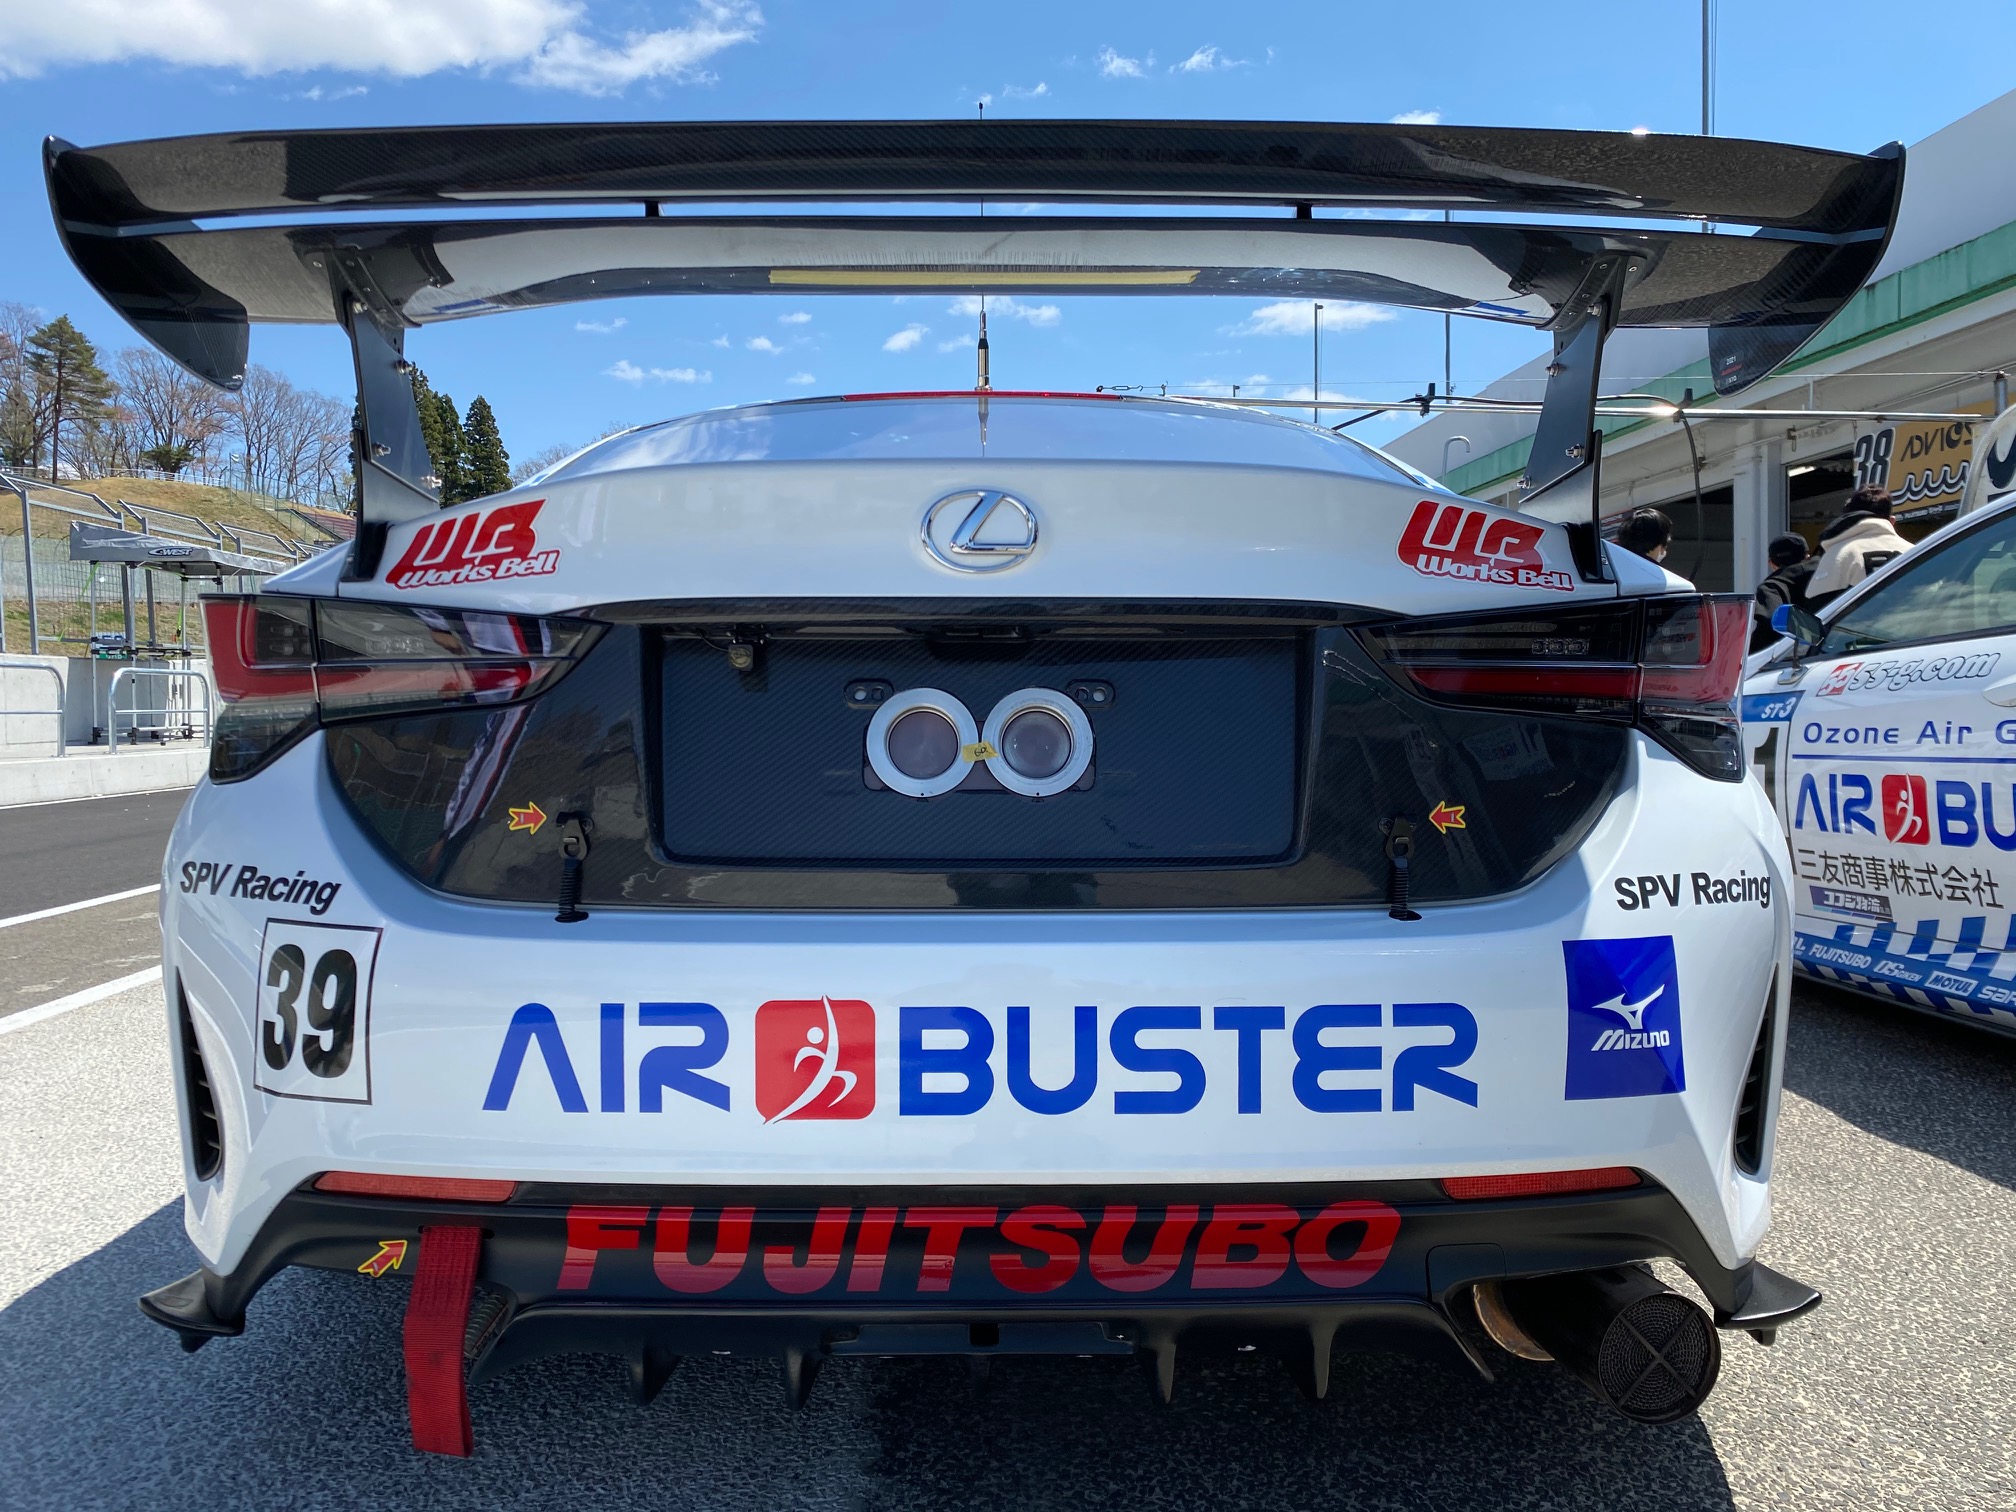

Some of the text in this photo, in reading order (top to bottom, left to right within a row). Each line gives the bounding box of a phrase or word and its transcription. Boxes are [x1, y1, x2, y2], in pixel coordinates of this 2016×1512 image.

[398, 550, 561, 589] Works Bell
[1414, 553, 1574, 591] Works Bell
[1761, 697, 1797, 719] ST3
[1803, 721, 1900, 745] Ozone
[1915, 720, 1974, 745] Air
[1795, 773, 1878, 837] AIR
[180, 861, 342, 916] SPV Racing
[1615, 869, 1771, 911] SPV Racing
[1797, 848, 2005, 911] 三友商事株式会社
[1809, 943, 1872, 970] FUJITSUBO
[1929, 974, 1974, 994] MOTUL
[262, 943, 358, 1079] 39
[482, 1001, 1480, 1117] AIR BUSTER
[556, 1198, 1403, 1294] FUJITSUBO
